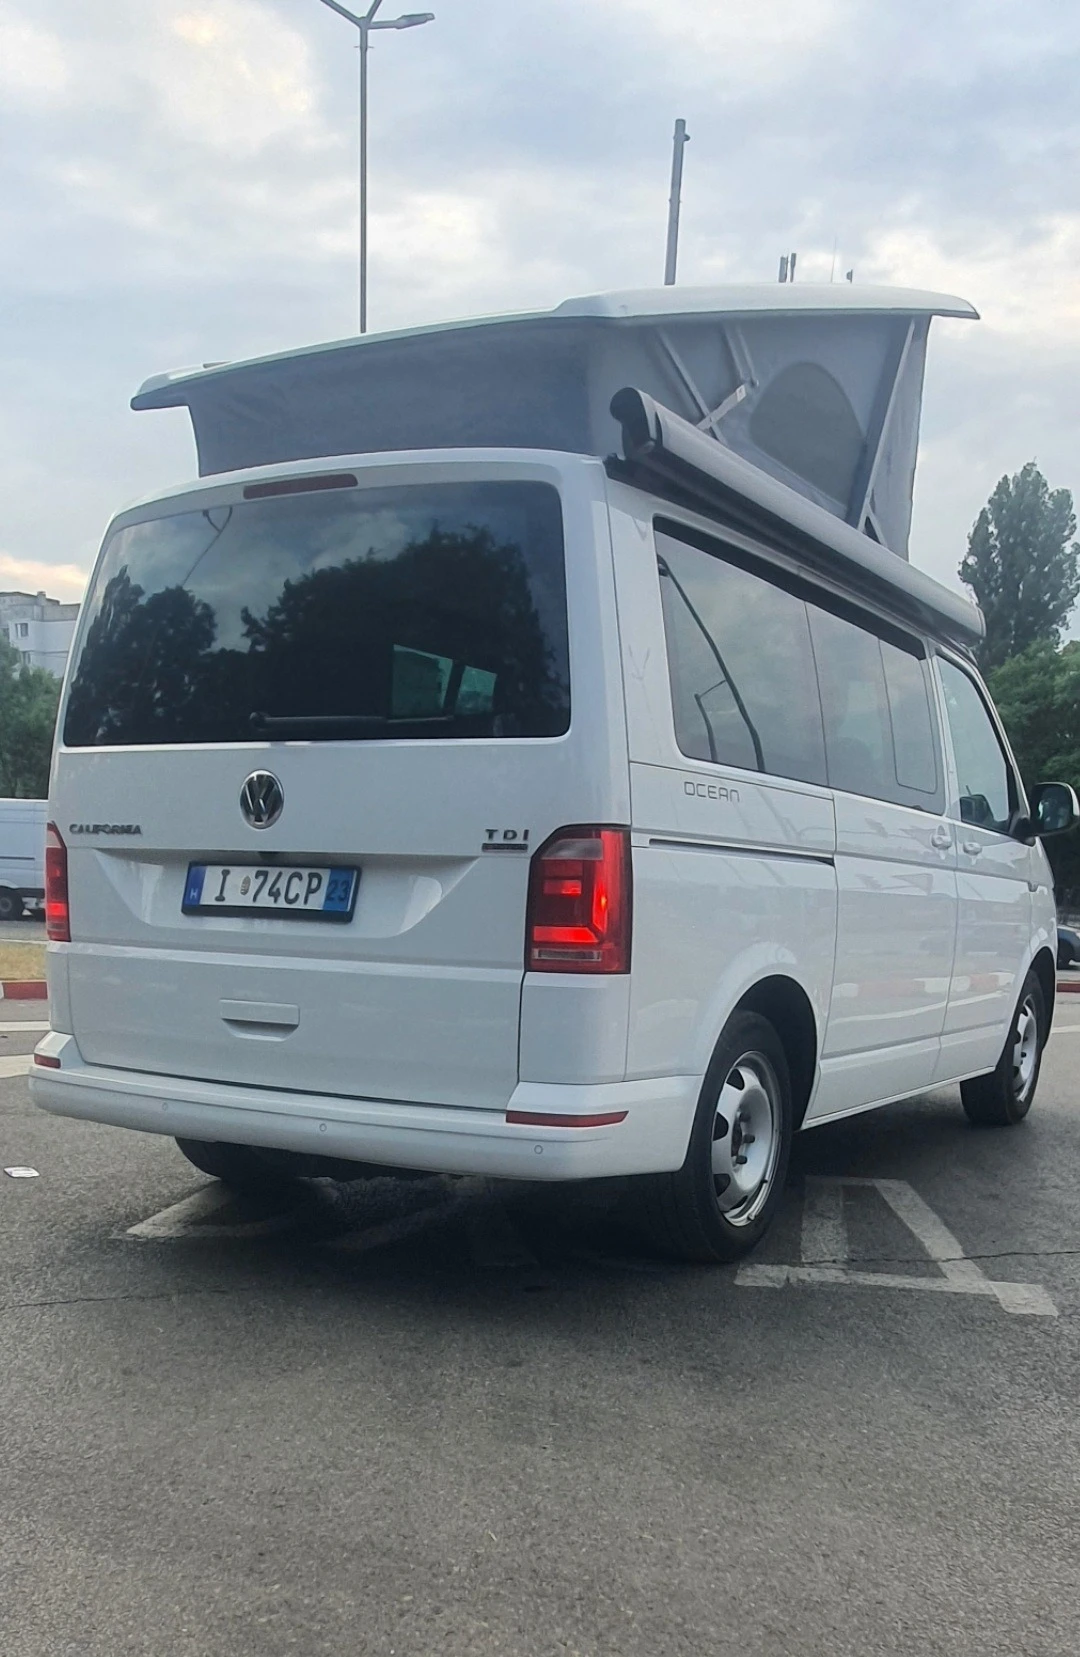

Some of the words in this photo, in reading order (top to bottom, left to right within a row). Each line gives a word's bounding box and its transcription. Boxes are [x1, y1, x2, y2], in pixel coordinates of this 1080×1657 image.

[684, 781, 740, 802] OCEAN
[69, 823, 142, 835] CALIFORNIA
[485, 829, 530, 841] TDI
